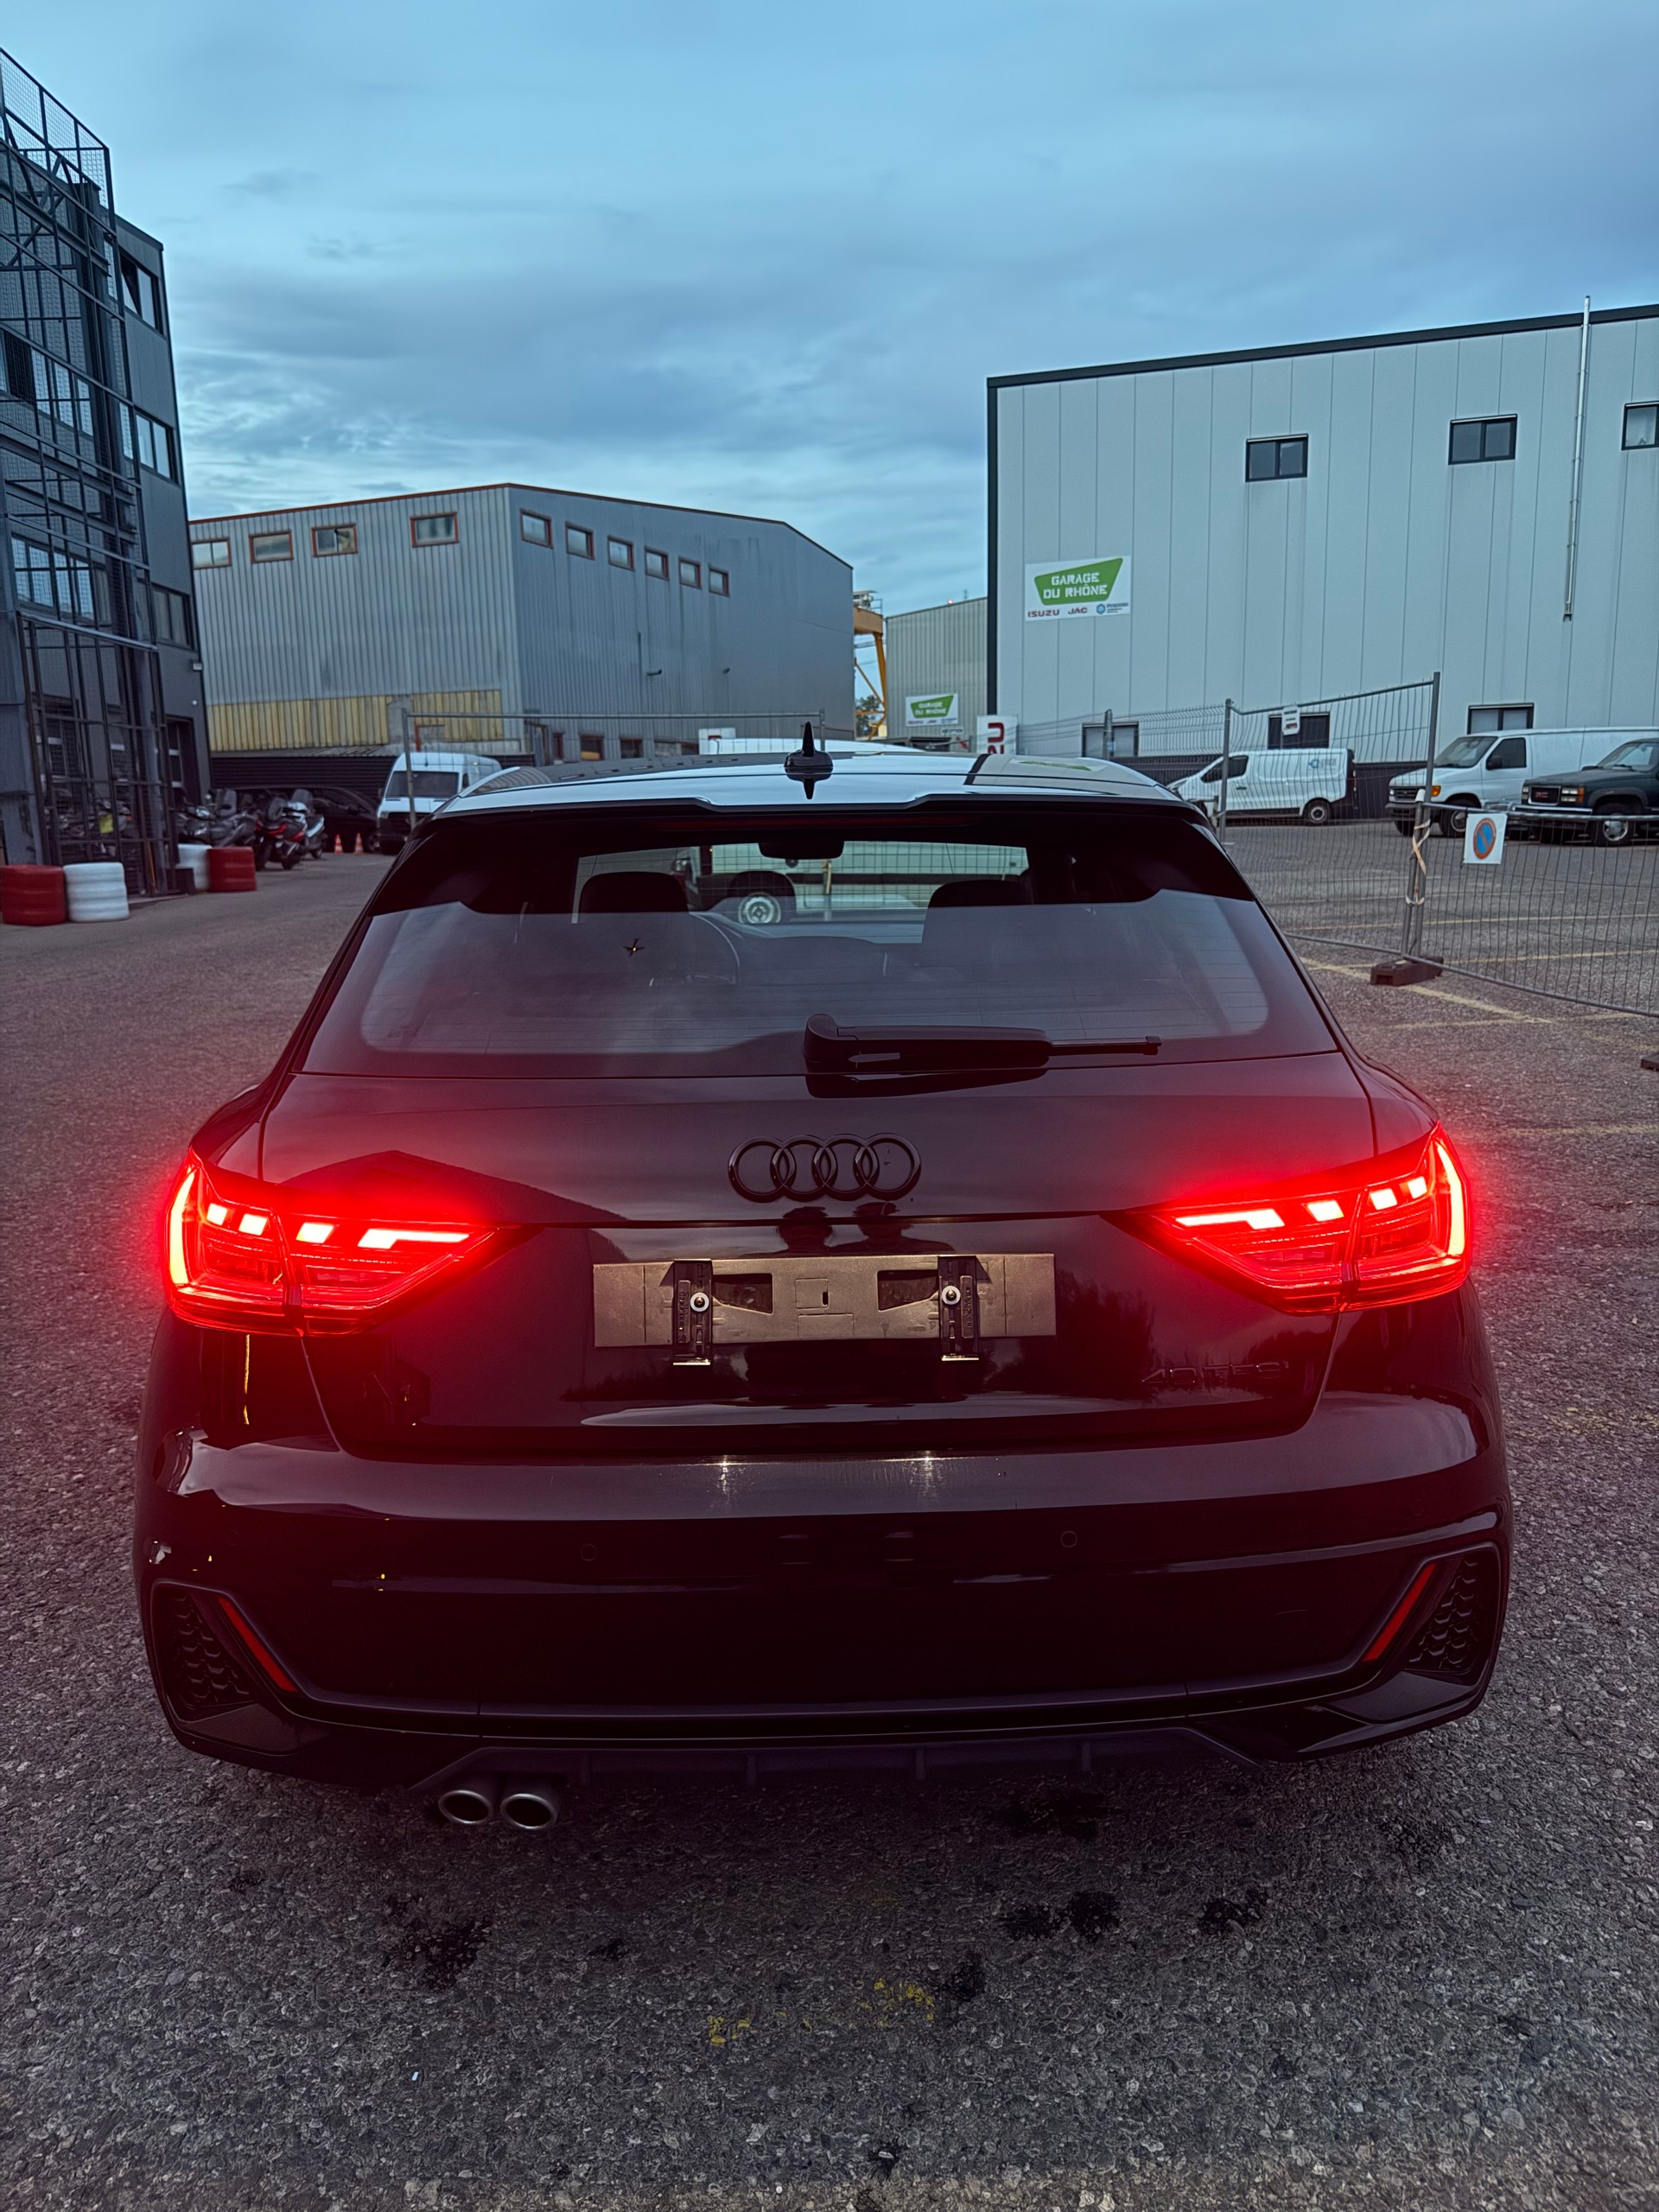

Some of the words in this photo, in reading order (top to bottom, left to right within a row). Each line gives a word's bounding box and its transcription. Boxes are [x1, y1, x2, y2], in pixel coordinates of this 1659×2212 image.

[1051, 572, 1100, 586] GARAGE
[1042, 588, 1061, 600] DU
[1065, 583, 1109, 598] RHÔNE
[1027, 608, 1060, 618] ISUZU
